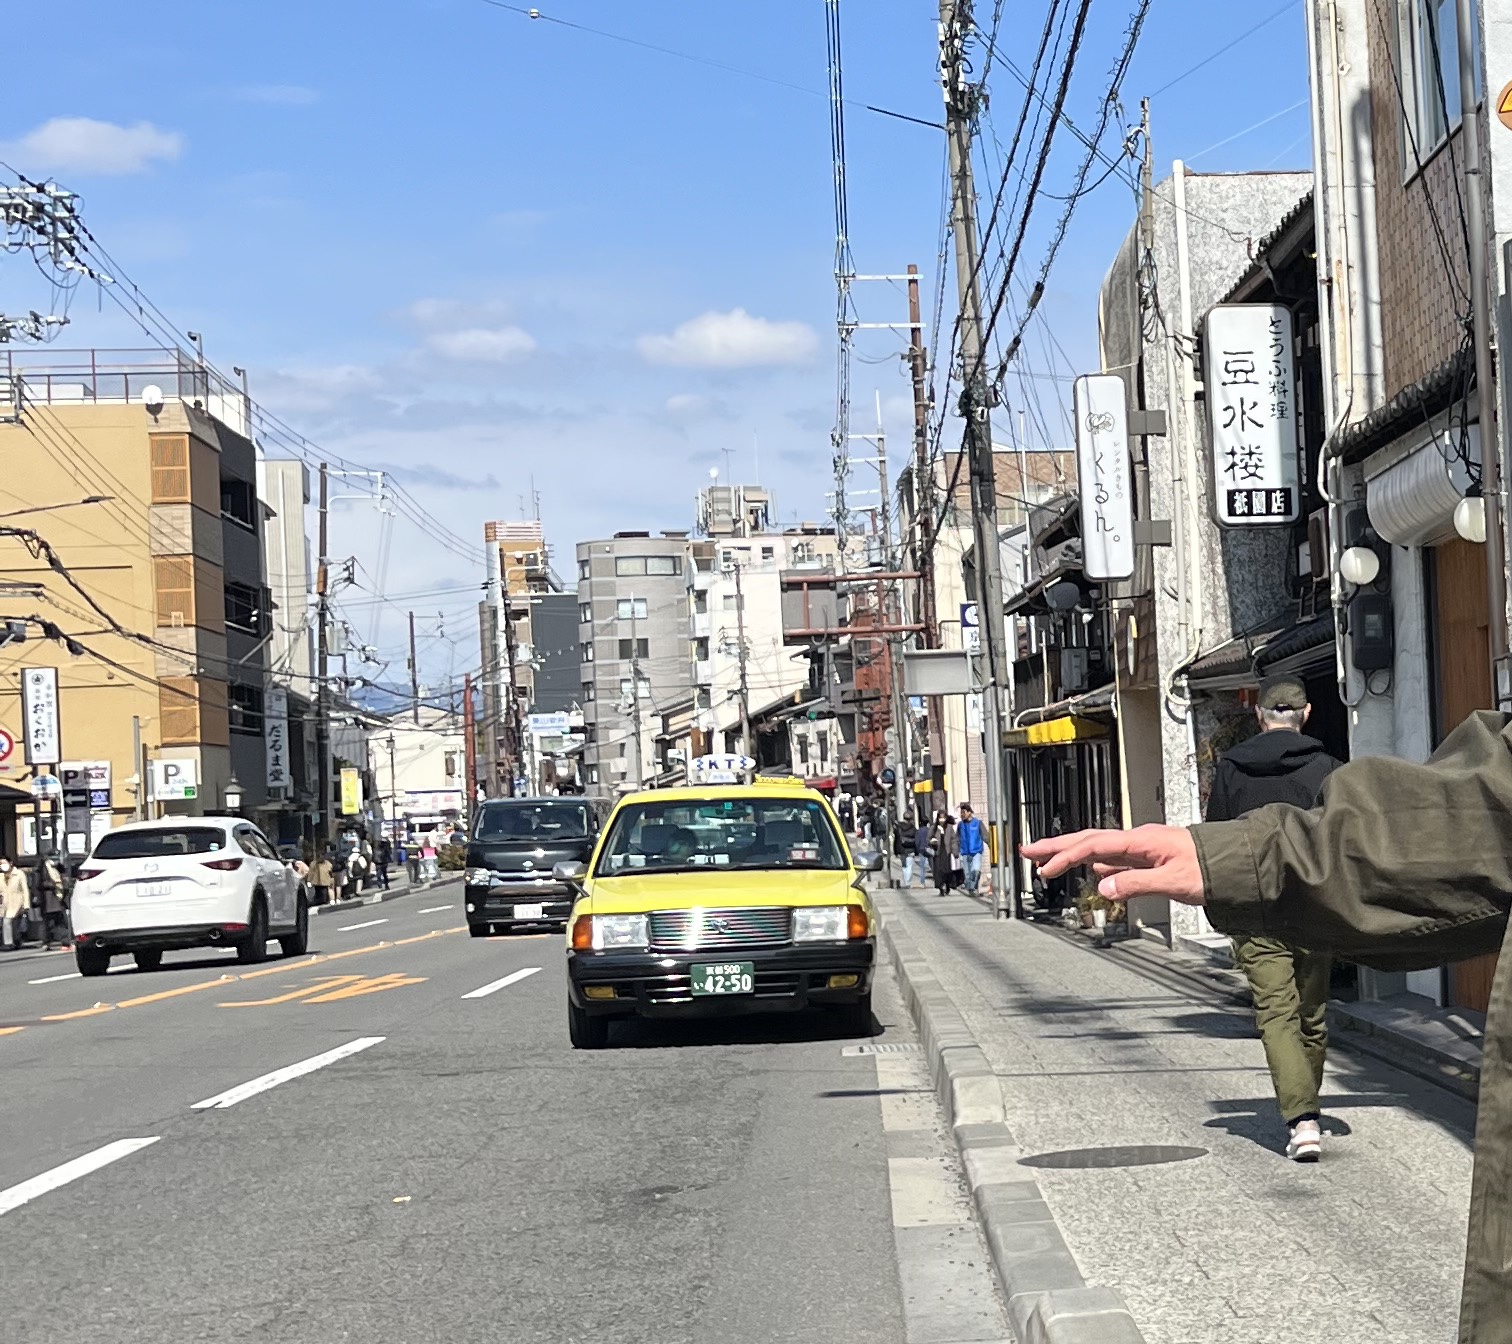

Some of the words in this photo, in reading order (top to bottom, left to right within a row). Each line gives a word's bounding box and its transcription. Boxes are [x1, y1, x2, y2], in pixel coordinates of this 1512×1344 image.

[1268, 315, 1289, 420] とうふ料理
[1220, 350, 1265, 482] 豆水楼
[64, 769, 79, 785] P
[163, 763, 181, 785] P
[704, 973, 752, 993] 42-50
